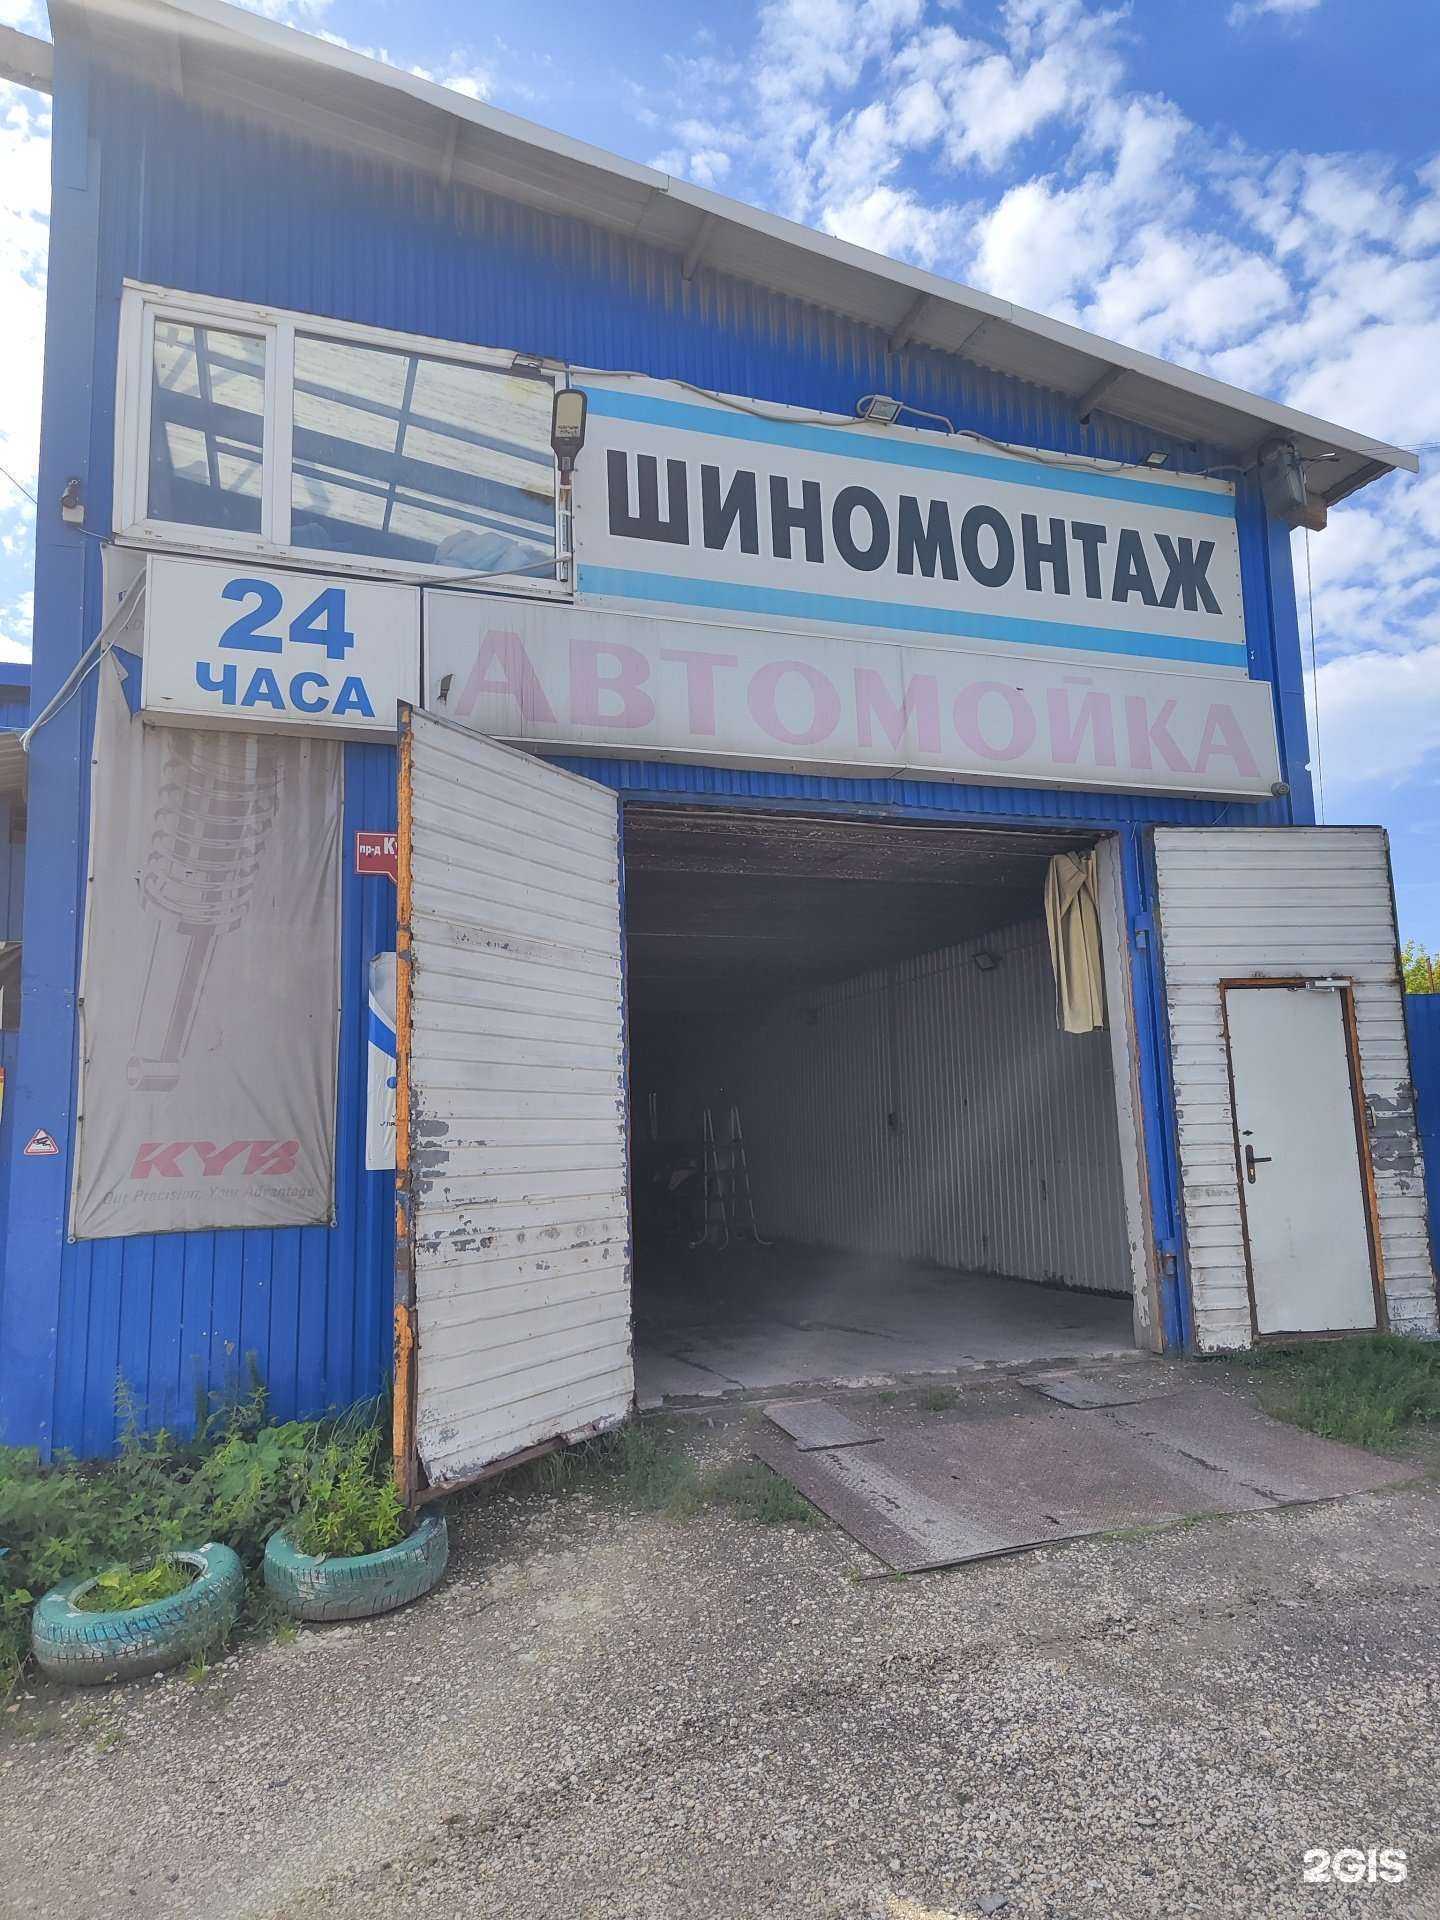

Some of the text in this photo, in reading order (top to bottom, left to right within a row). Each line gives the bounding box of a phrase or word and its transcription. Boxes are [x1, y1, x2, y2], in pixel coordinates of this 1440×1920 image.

[606, 449, 1223, 615] ШИНОМОНТАЖ
[218, 578, 355, 661] 24
[195, 661, 376, 718] ЧАСА
[454, 629, 1261, 778] АВТОМОЙКА
[383, 837, 398, 860] К
[130, 1140, 300, 1179] KYB
